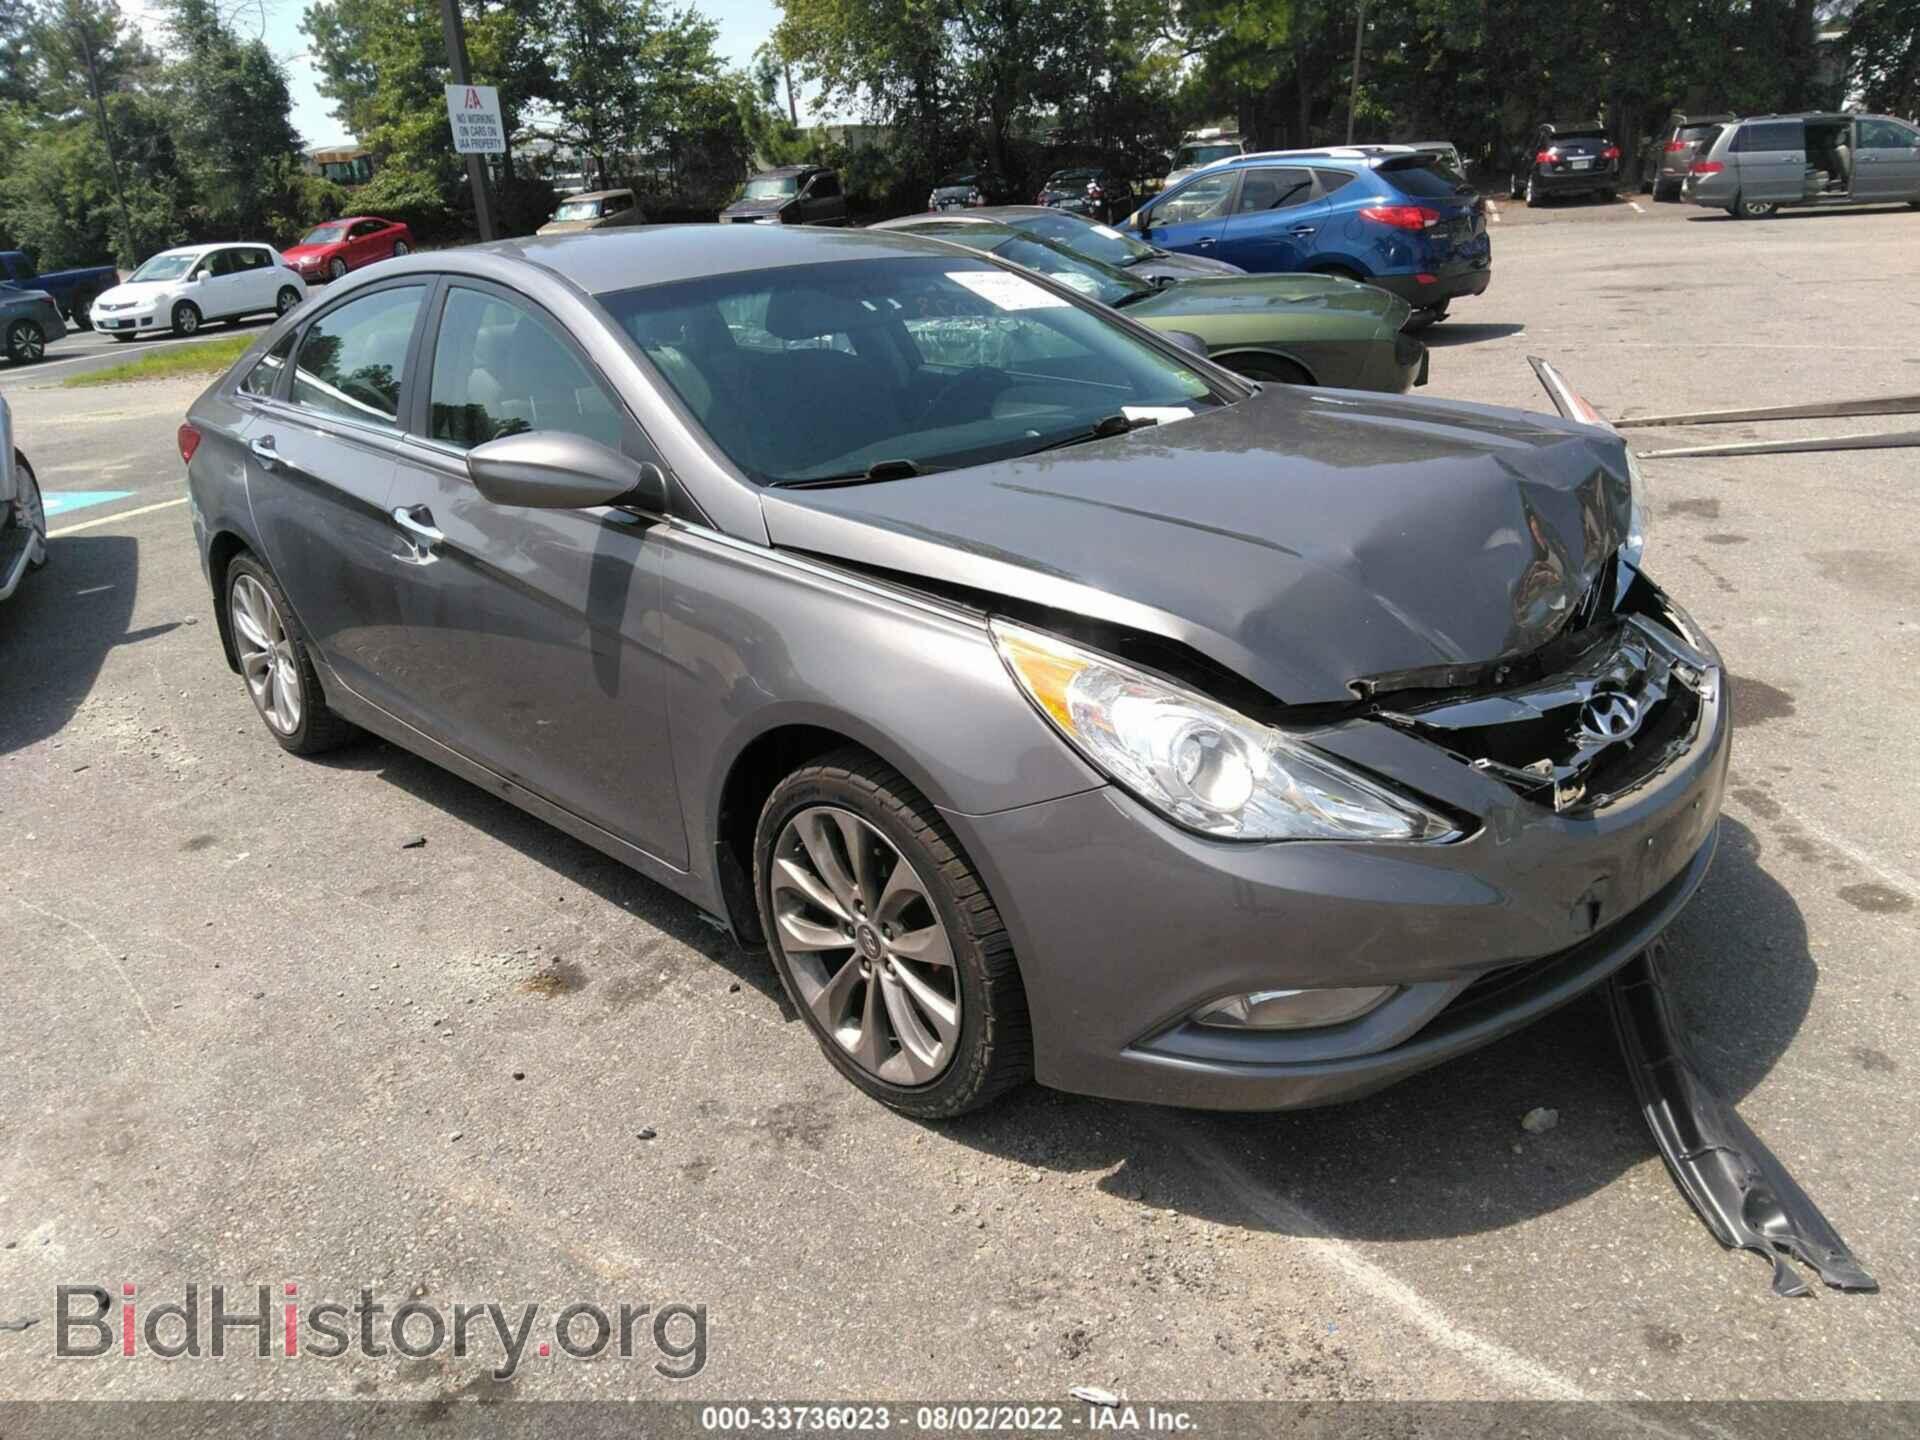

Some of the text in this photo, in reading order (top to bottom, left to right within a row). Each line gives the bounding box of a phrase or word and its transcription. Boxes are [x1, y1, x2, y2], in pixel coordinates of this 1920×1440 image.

[456, 113, 496, 125] NO WORKING
[459, 126, 497, 137] ON CARS ON
[458, 138, 501, 149] IAA PROPERTY
